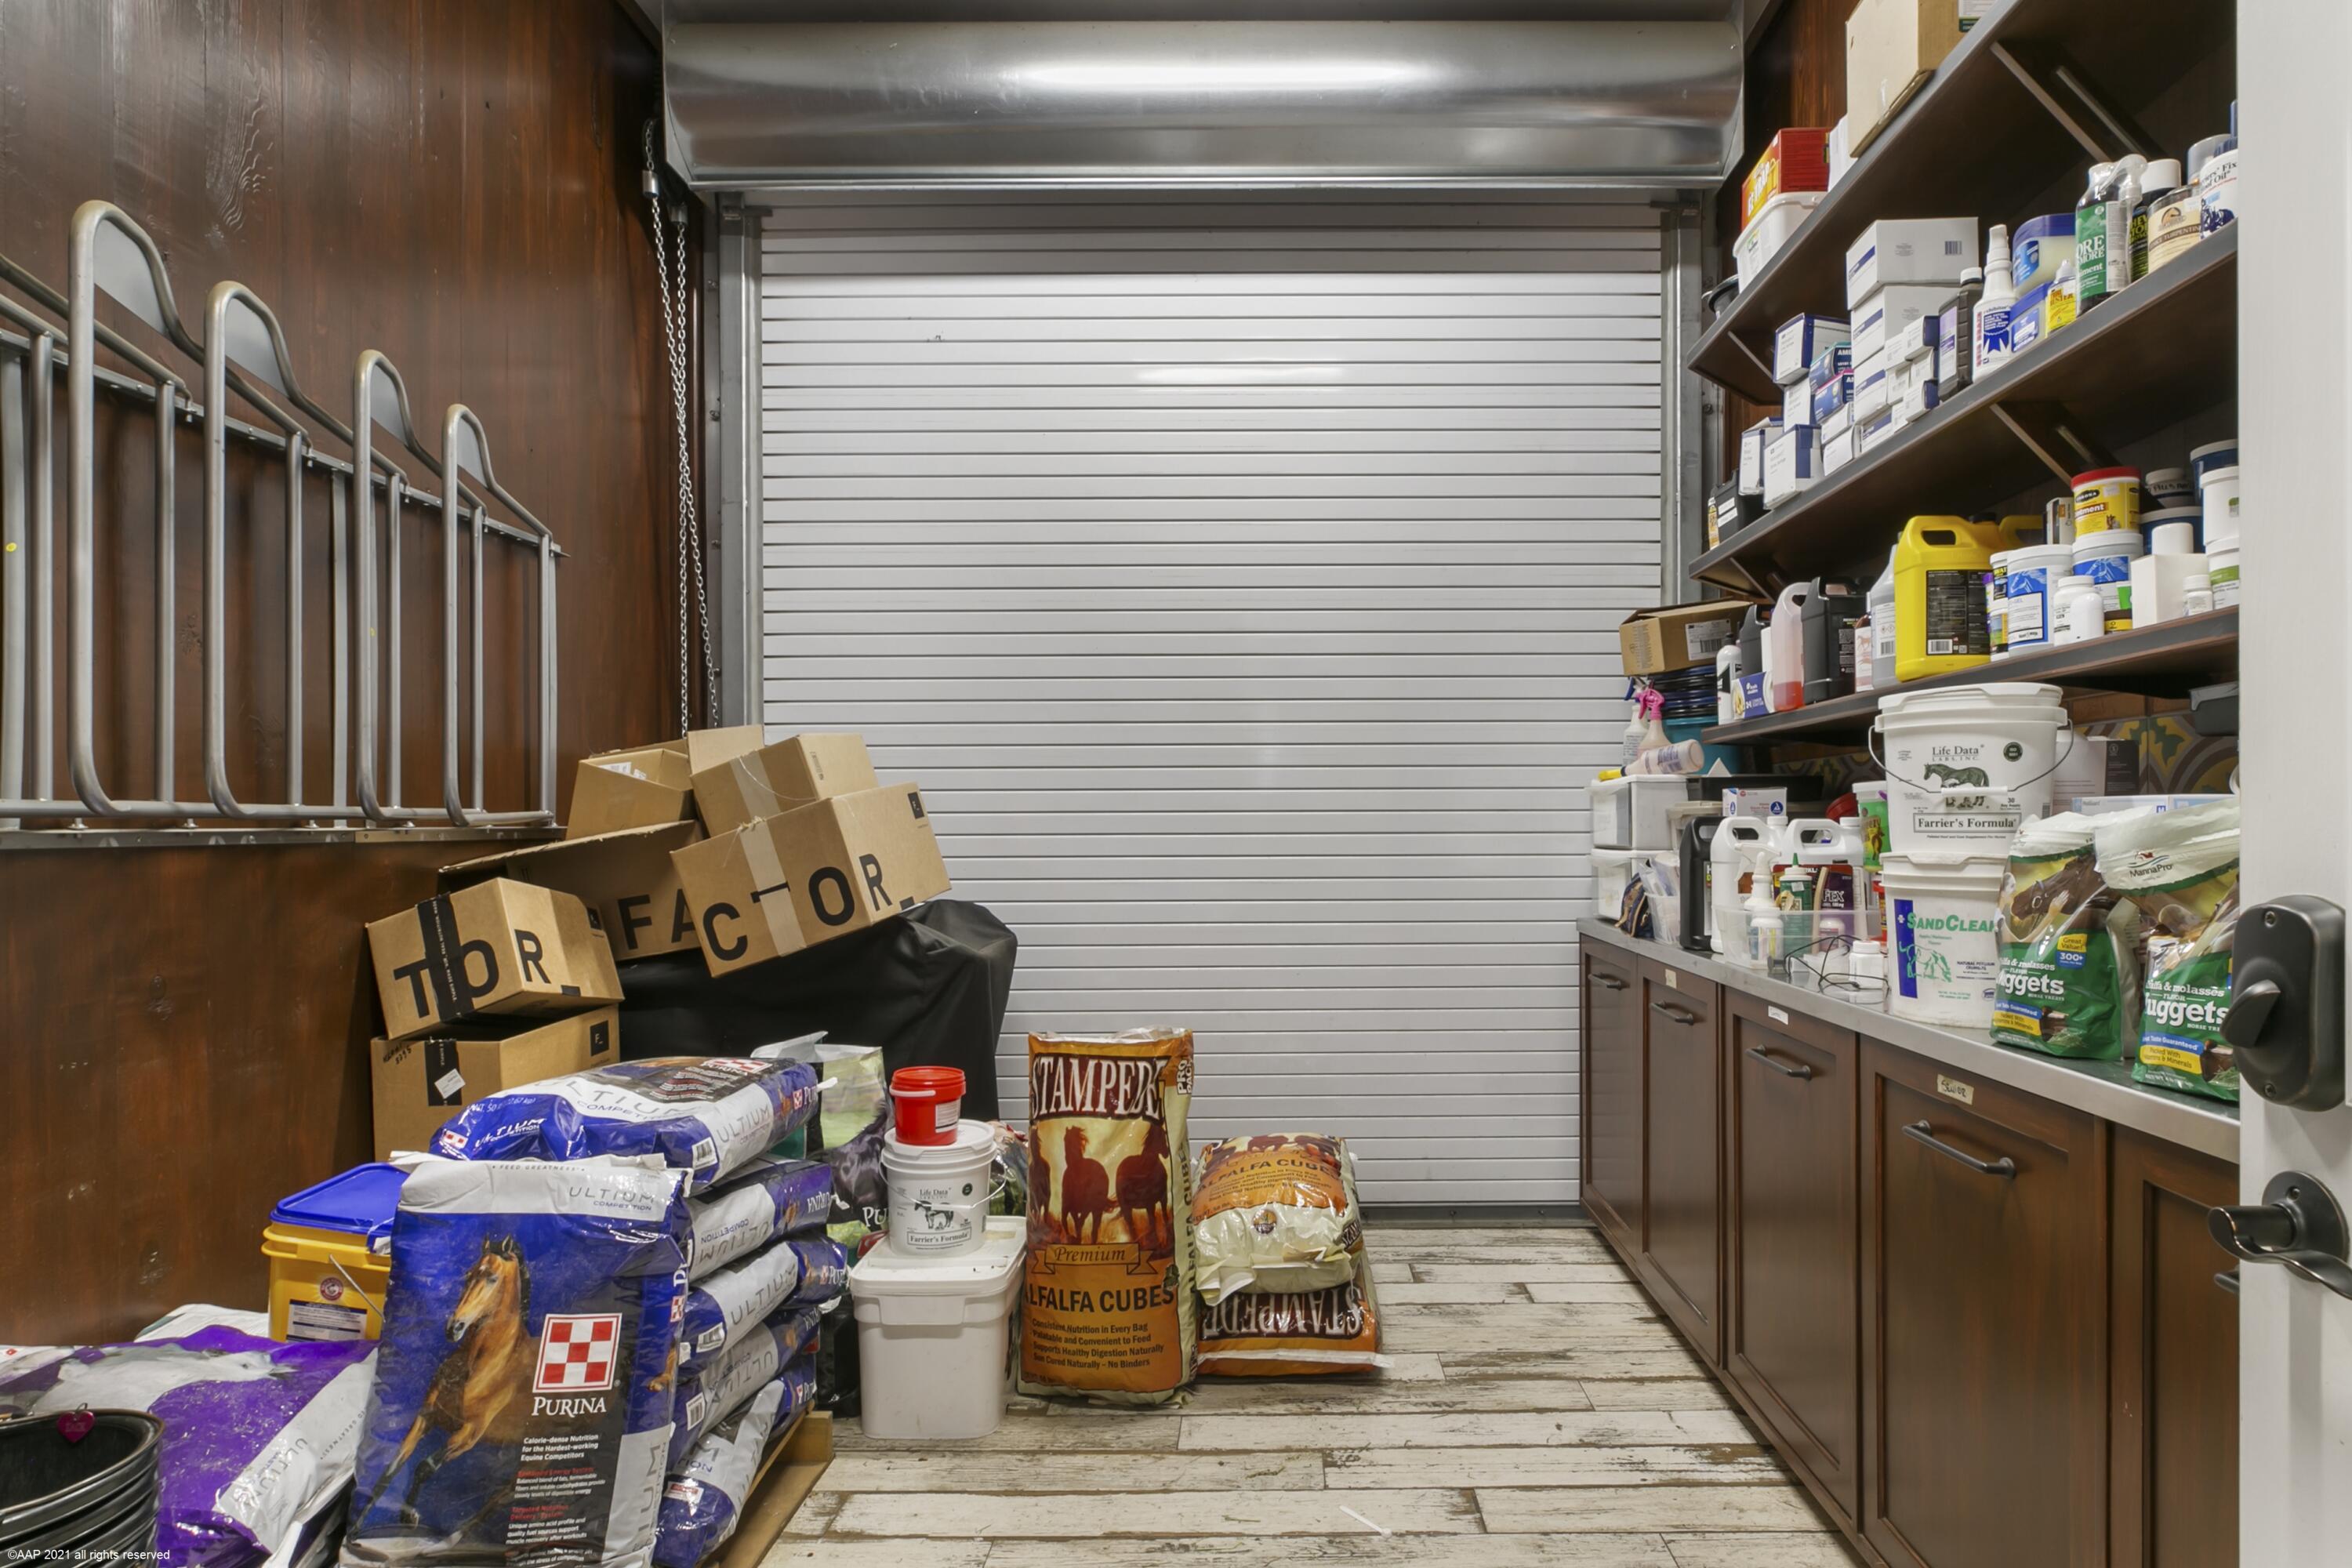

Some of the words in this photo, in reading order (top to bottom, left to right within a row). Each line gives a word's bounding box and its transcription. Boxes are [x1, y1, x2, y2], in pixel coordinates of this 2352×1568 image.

[1932, 746, 1951, 757] Life
[1954, 745, 1980, 756] Data
[1918, 817, 1964, 829] Farrier's
[2060, 952, 2084, 962] 300+
[2172, 984, 2226, 998] molasses
[715, 1105, 771, 1145] ULTIUM
[568, 1186, 655, 1204] ULTIUM
[1054, 1246, 1126, 1263] Premium
[1099, 1283, 1175, 1314] CUBES
[1033, 1319, 1067, 1332] Consistent
[1066, 1326, 1100, 1334] Nutrition
[1110, 1325, 1131, 1334] Every
[1132, 1323, 1149, 1333] Bag
[1063, 1334, 1077, 1345] and
[1077, 1337, 1122, 1345] Convenient
[1132, 1334, 1152, 1344] Feed
[1062, 1348, 1090, 1359] Healthy
[1091, 1348, 1127, 1359] Digestion
[1129, 1344, 1165, 1356] Naturally
[1046, 1356, 1066, 1367] Cured
[1066, 1358, 1101, 1370] Naturally
[1108, 1360, 1119, 1369] No
[1120, 1357, 1151, 1368] Binders
[531, 1397, 608, 1417] PURINA
[523, 1436, 569, 1445] Calorie-dense
[569, 1434, 600, 1443] Nutrition
[544, 1442, 600, 1452] Hardest-working
[544, 1452, 586, 1461] Competitors
[557, 1519, 575, 1527] profile
